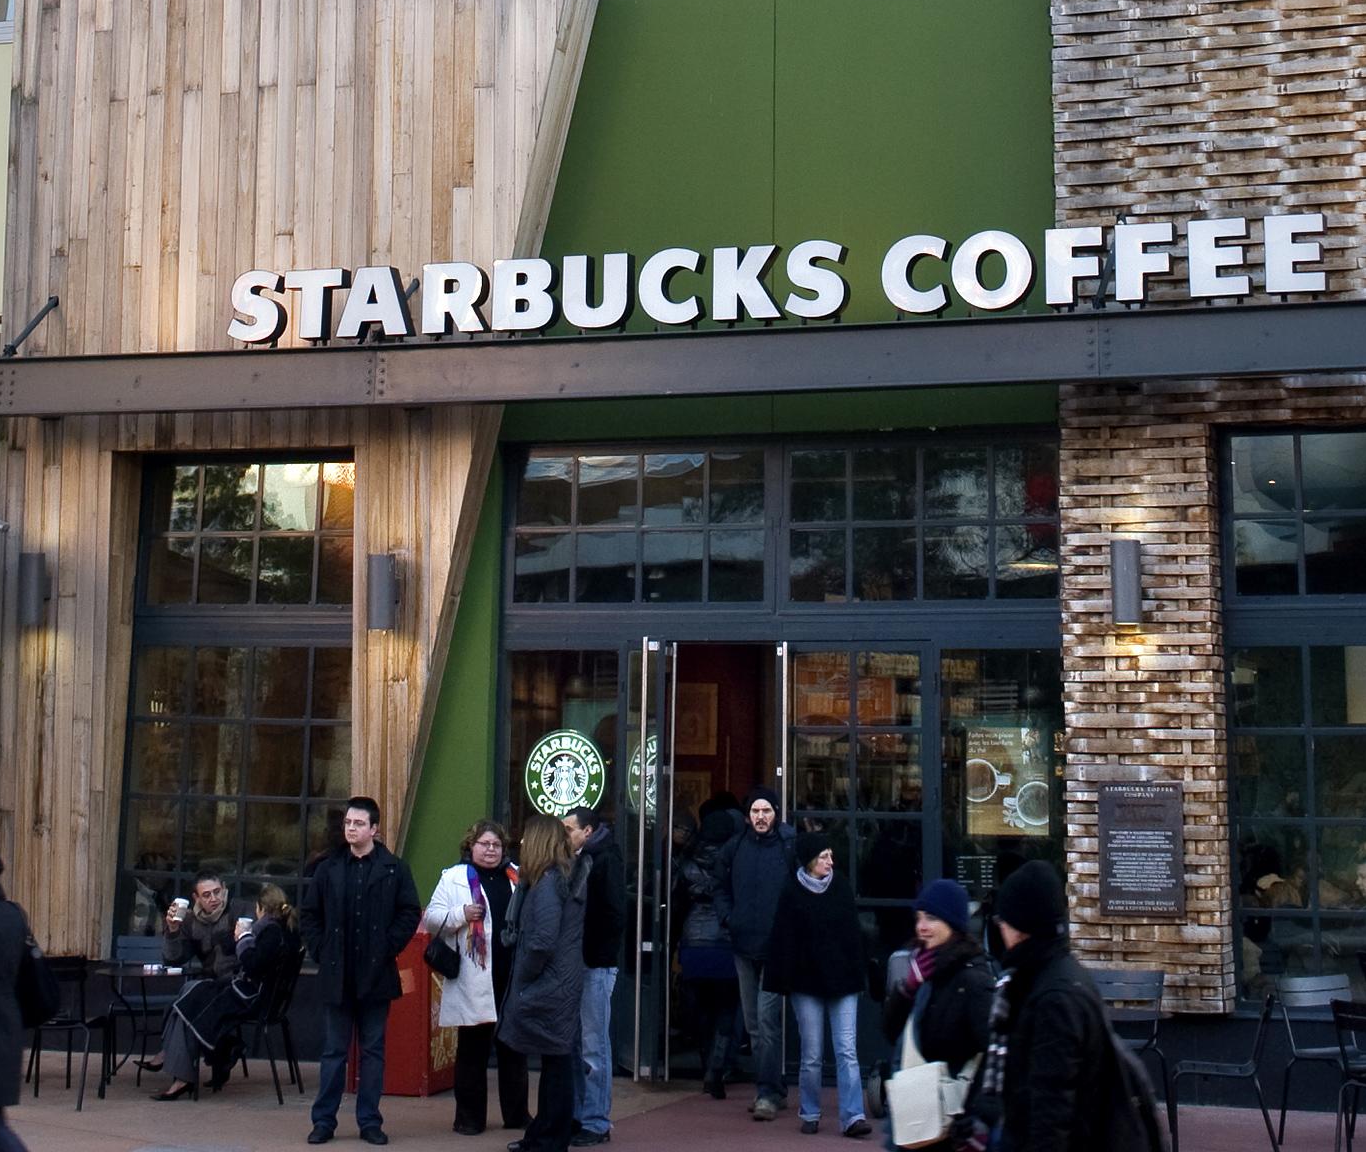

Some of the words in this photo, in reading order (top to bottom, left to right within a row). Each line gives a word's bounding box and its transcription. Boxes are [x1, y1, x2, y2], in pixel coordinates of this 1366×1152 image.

[226, 239, 846, 344] STARBUCKS
[881, 212, 1328, 314] COFFEE
[530, 736, 601, 775] STARBUCKS
